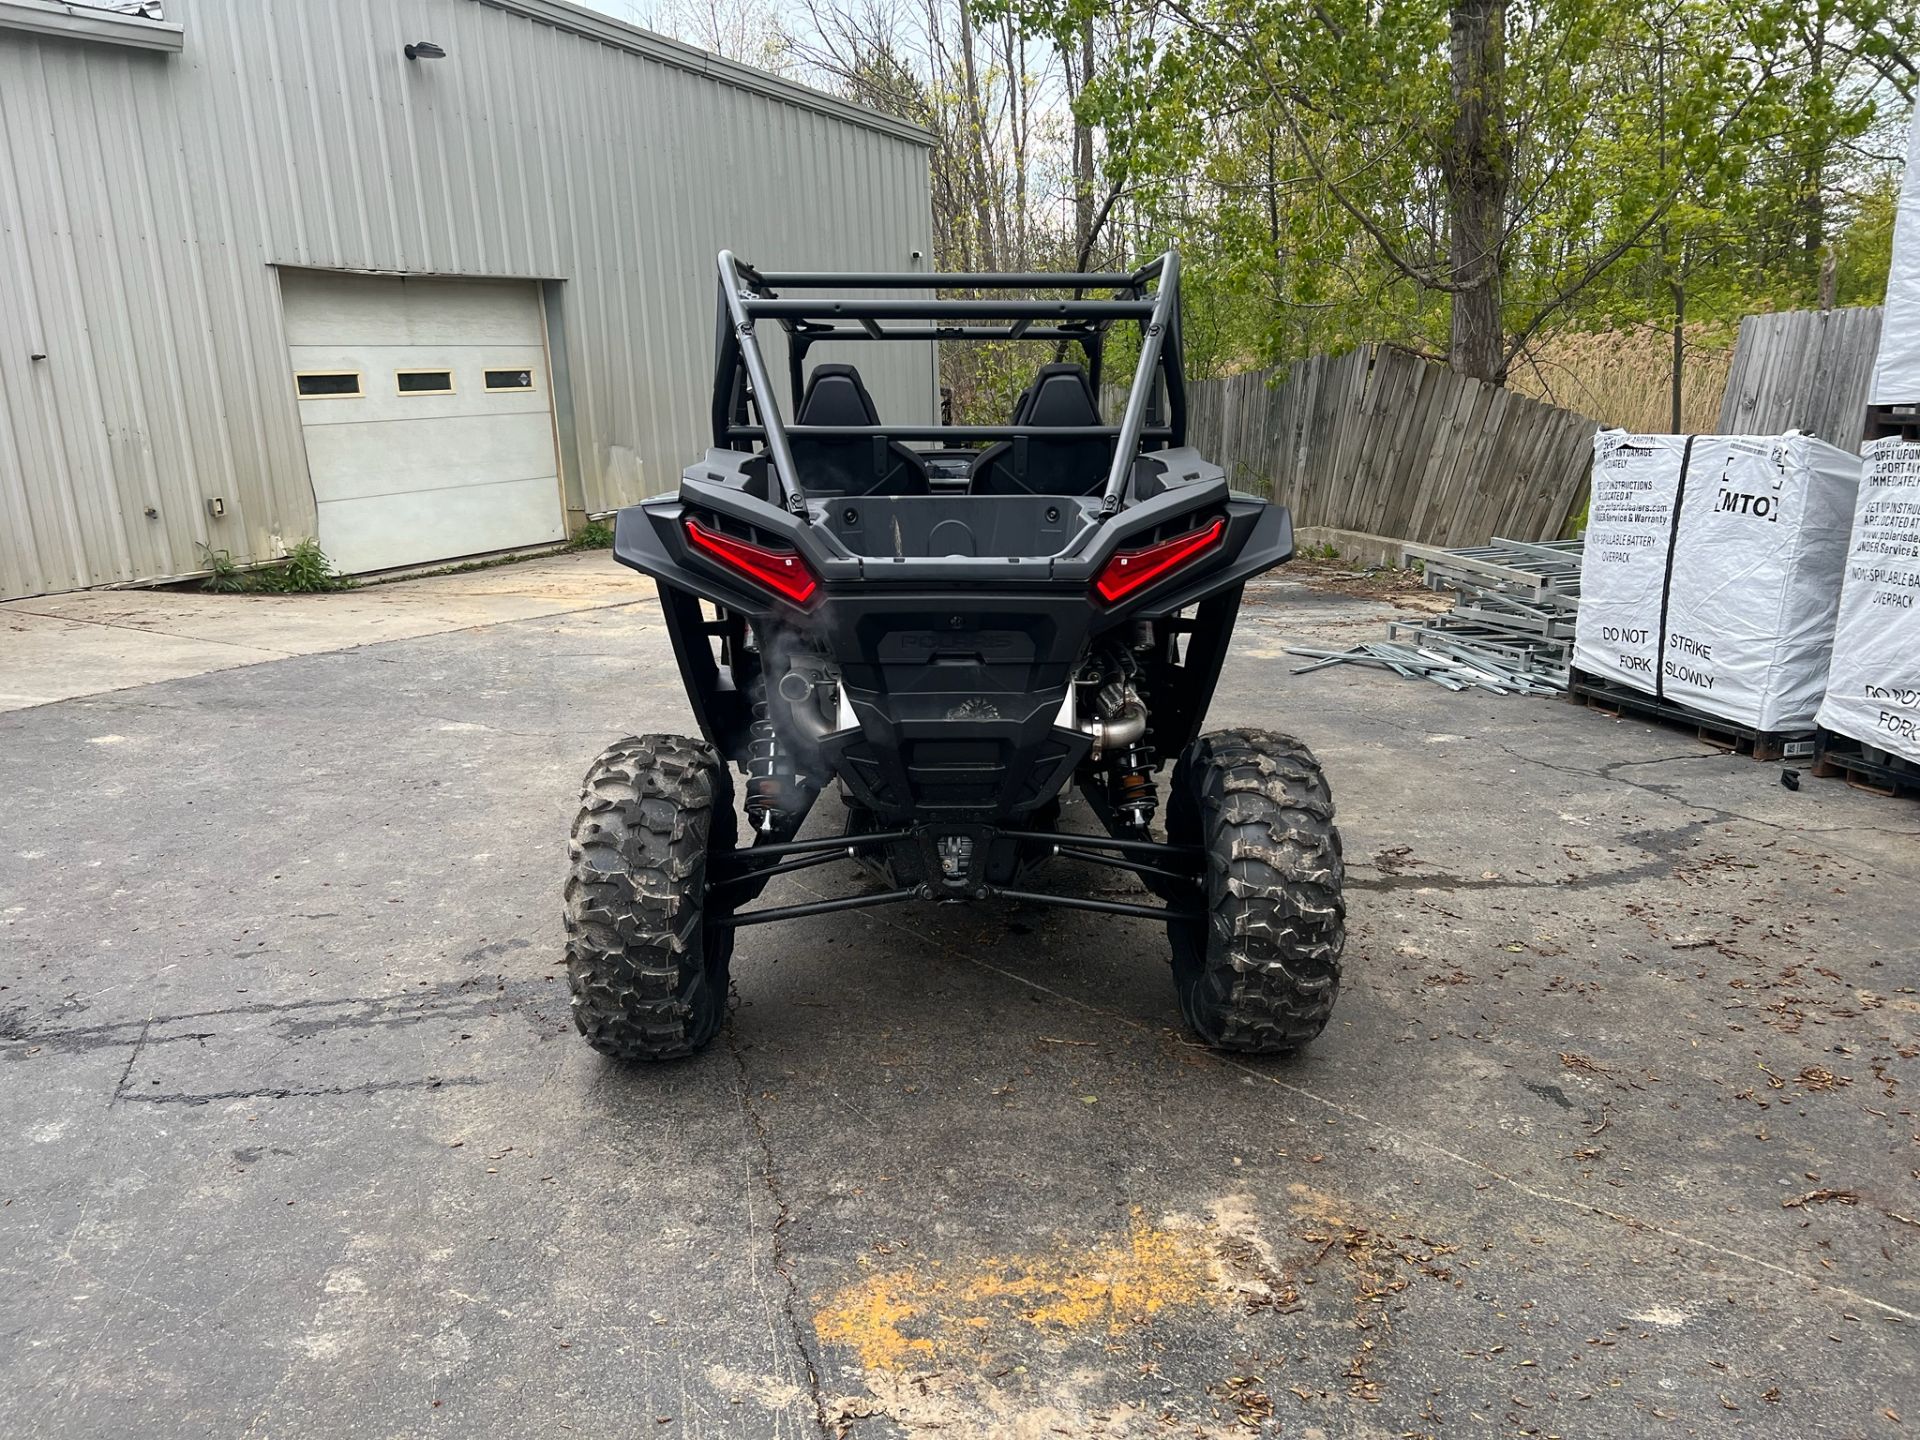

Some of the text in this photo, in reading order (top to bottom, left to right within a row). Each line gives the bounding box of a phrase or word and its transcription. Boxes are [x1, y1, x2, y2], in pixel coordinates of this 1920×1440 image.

[1627, 449, 1653, 458] DAMAGE
[1874, 462, 1906, 474] EPORT
[1610, 481, 1653, 491] INSTRUCTIONS
[1625, 492, 1633, 501] AT
[1722, 491, 1770, 517] MTO
[1607, 513, 1627, 522] Service
[1628, 514, 1634, 522] &
[1634, 513, 1668, 525] Warranty
[1627, 534, 1656, 547] BATTERY
[1602, 551, 1630, 563] OVERPACK
[1880, 543, 1911, 557] Service
[1911, 545, 1919, 558] &
[1873, 590, 1915, 609] OVERPACK
[1602, 626, 1712, 660] DO NOT STRIKE
[1619, 654, 1715, 690] FORK SLOWLY
[1878, 710, 1920, 742] FORK
